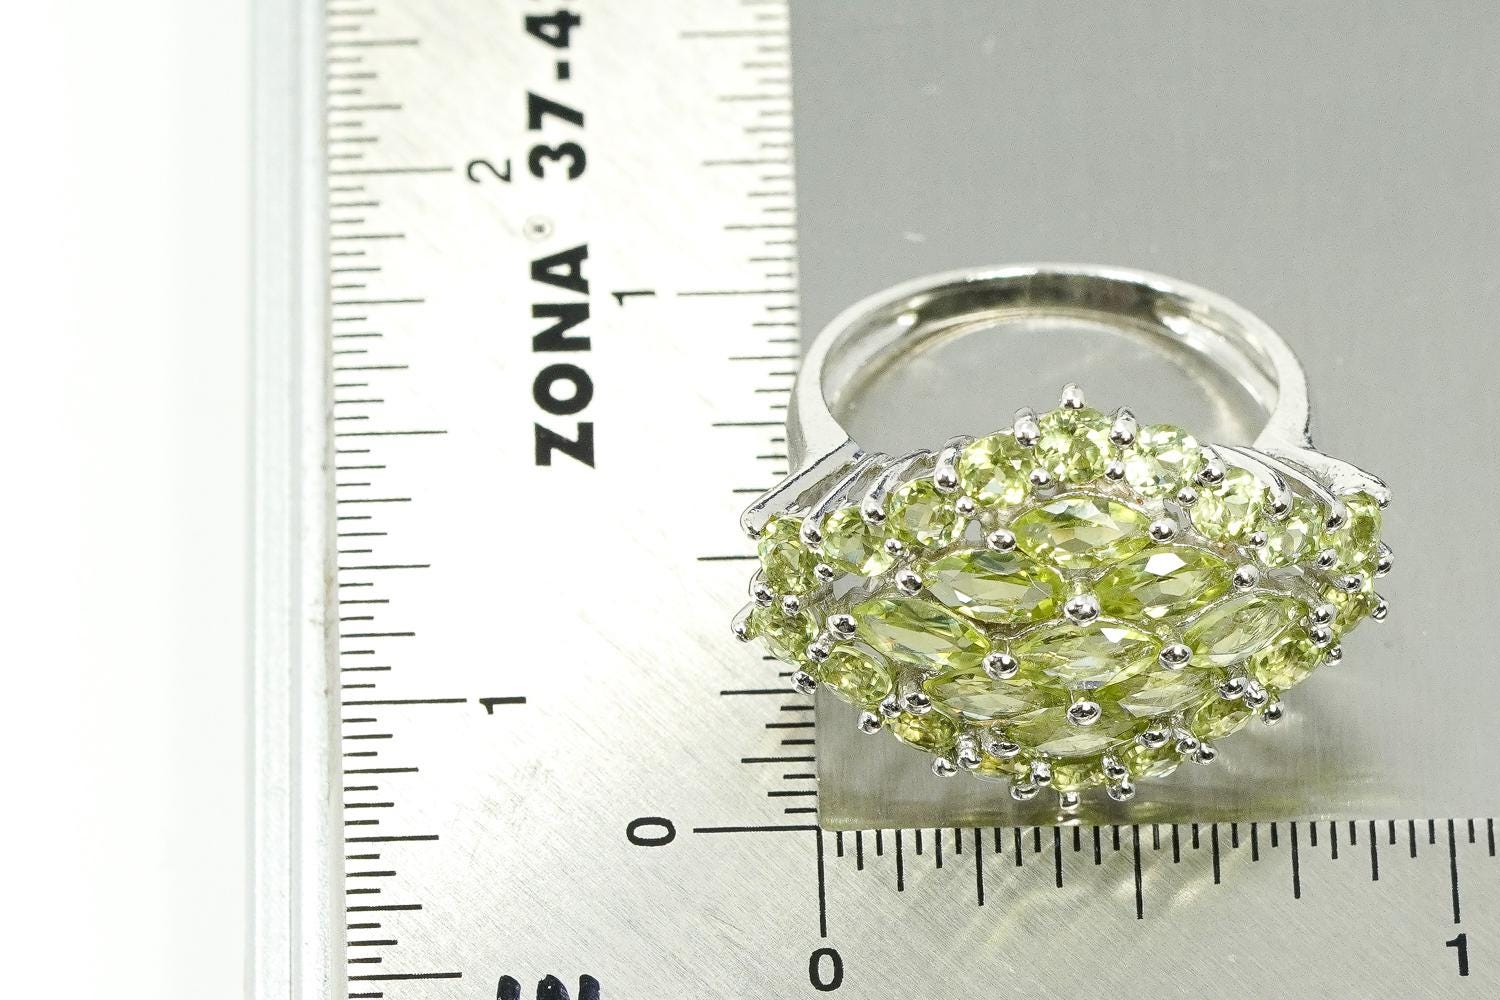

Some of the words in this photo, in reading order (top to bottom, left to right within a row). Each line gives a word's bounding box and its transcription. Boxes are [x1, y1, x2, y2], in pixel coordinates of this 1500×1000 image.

[524, 0, 587, 179] 37-4
[466, 158, 512, 184] 2
[611, 290, 656, 306] 1
[530, 243, 596, 469] ZONA
[478, 695, 528, 716] 1
[625, 815, 678, 848] 0
[807, 946, 845, 993] 0
[1444, 931, 1471, 978] 1
